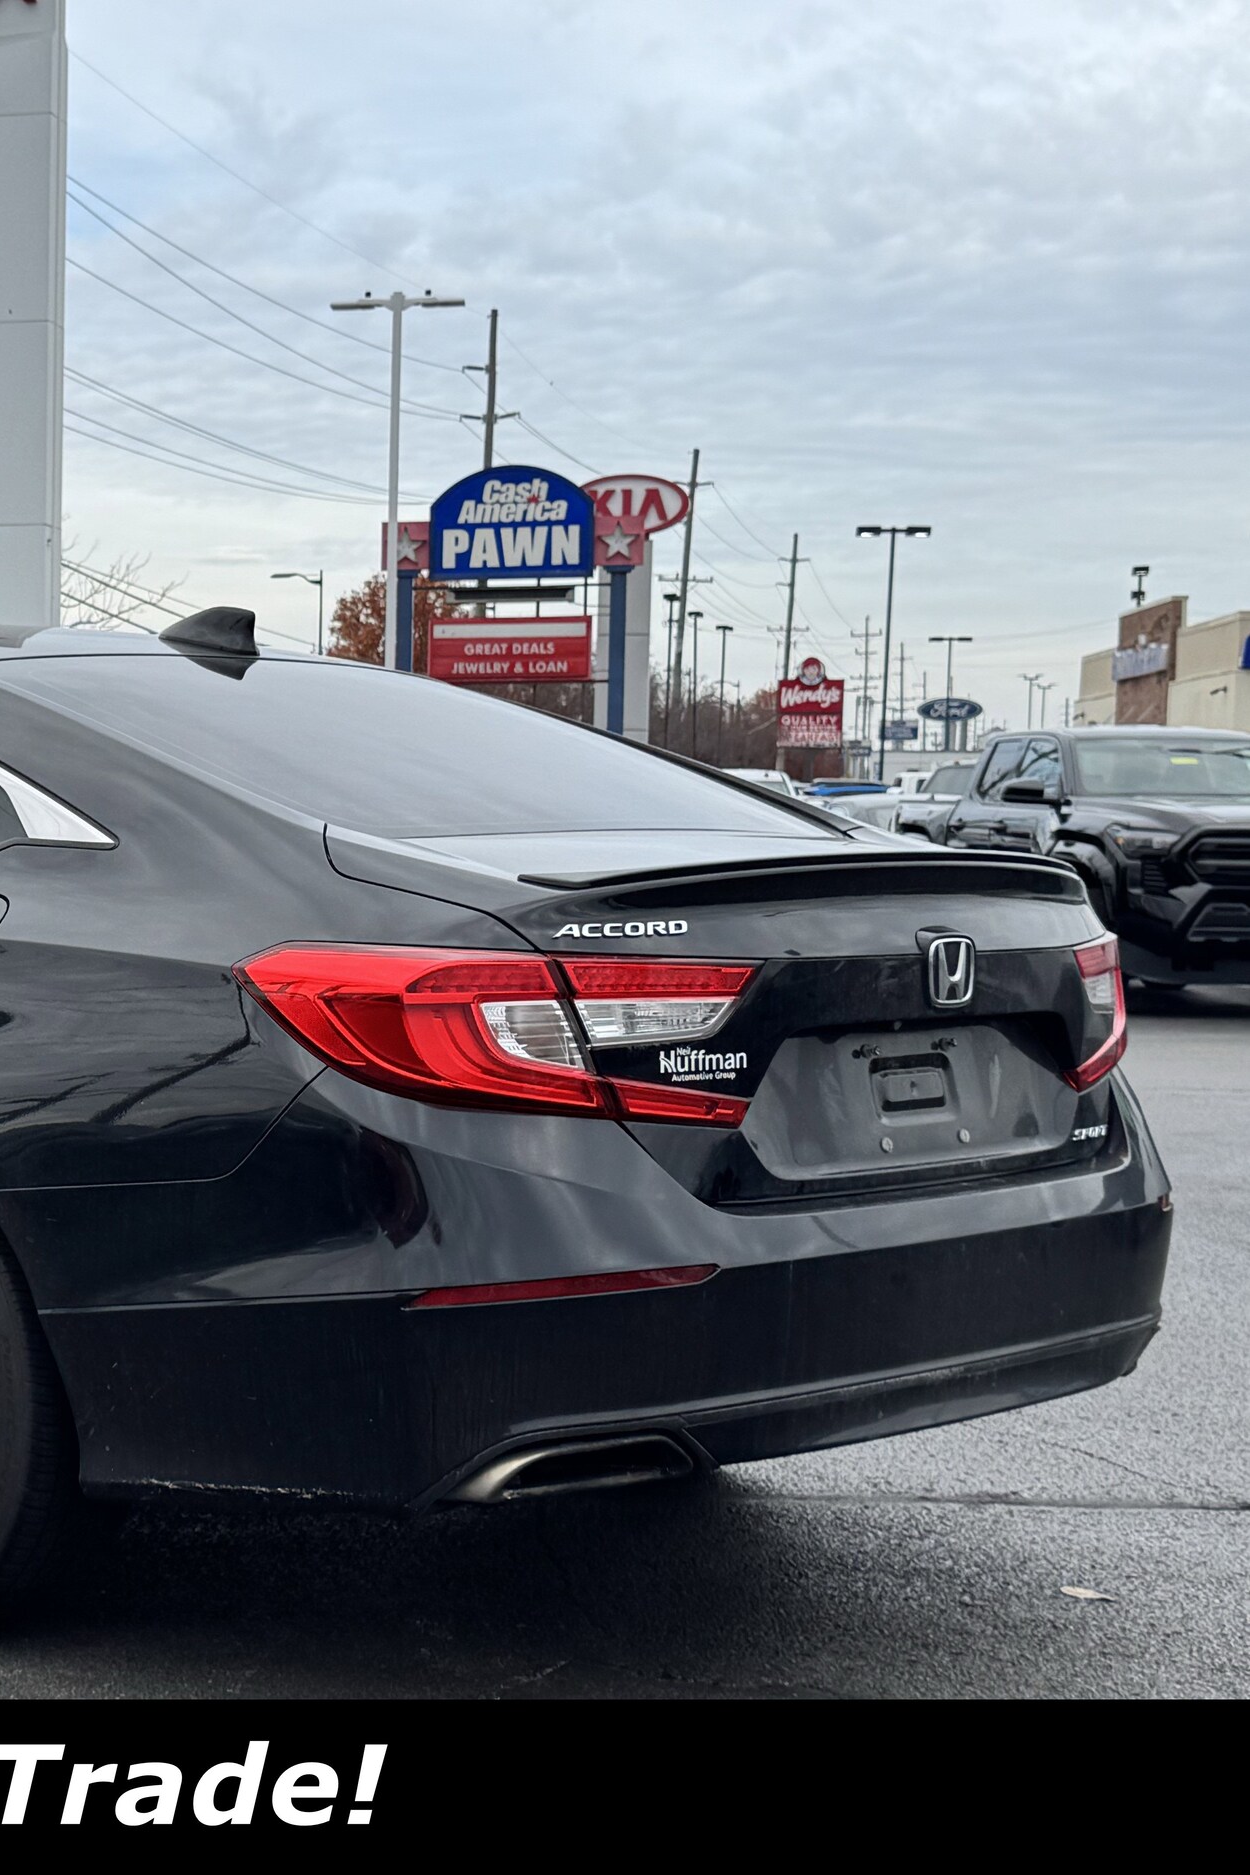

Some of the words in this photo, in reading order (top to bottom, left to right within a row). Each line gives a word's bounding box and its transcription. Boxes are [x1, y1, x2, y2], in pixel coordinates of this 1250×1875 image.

[482, 478, 549, 503] Cash
[457, 500, 568, 525] America
[590, 488, 668, 521] KIA
[441, 524, 580, 569] PAWN
[464, 643, 508, 656] GREAT
[512, 642, 555, 655] DEALS
[451, 661, 510, 675] JEWELRY
[514, 661, 524, 673] &
[529, 661, 568, 673] LOAN
[781, 684, 841, 709] Wendy's
[781, 714, 838, 726] QUALITY
[553, 920, 689, 939] ACCORD
[659, 1049, 748, 1074] Huffman
[671, 1071, 714, 1083] Automotive
[714, 1071, 737, 1081] Group
